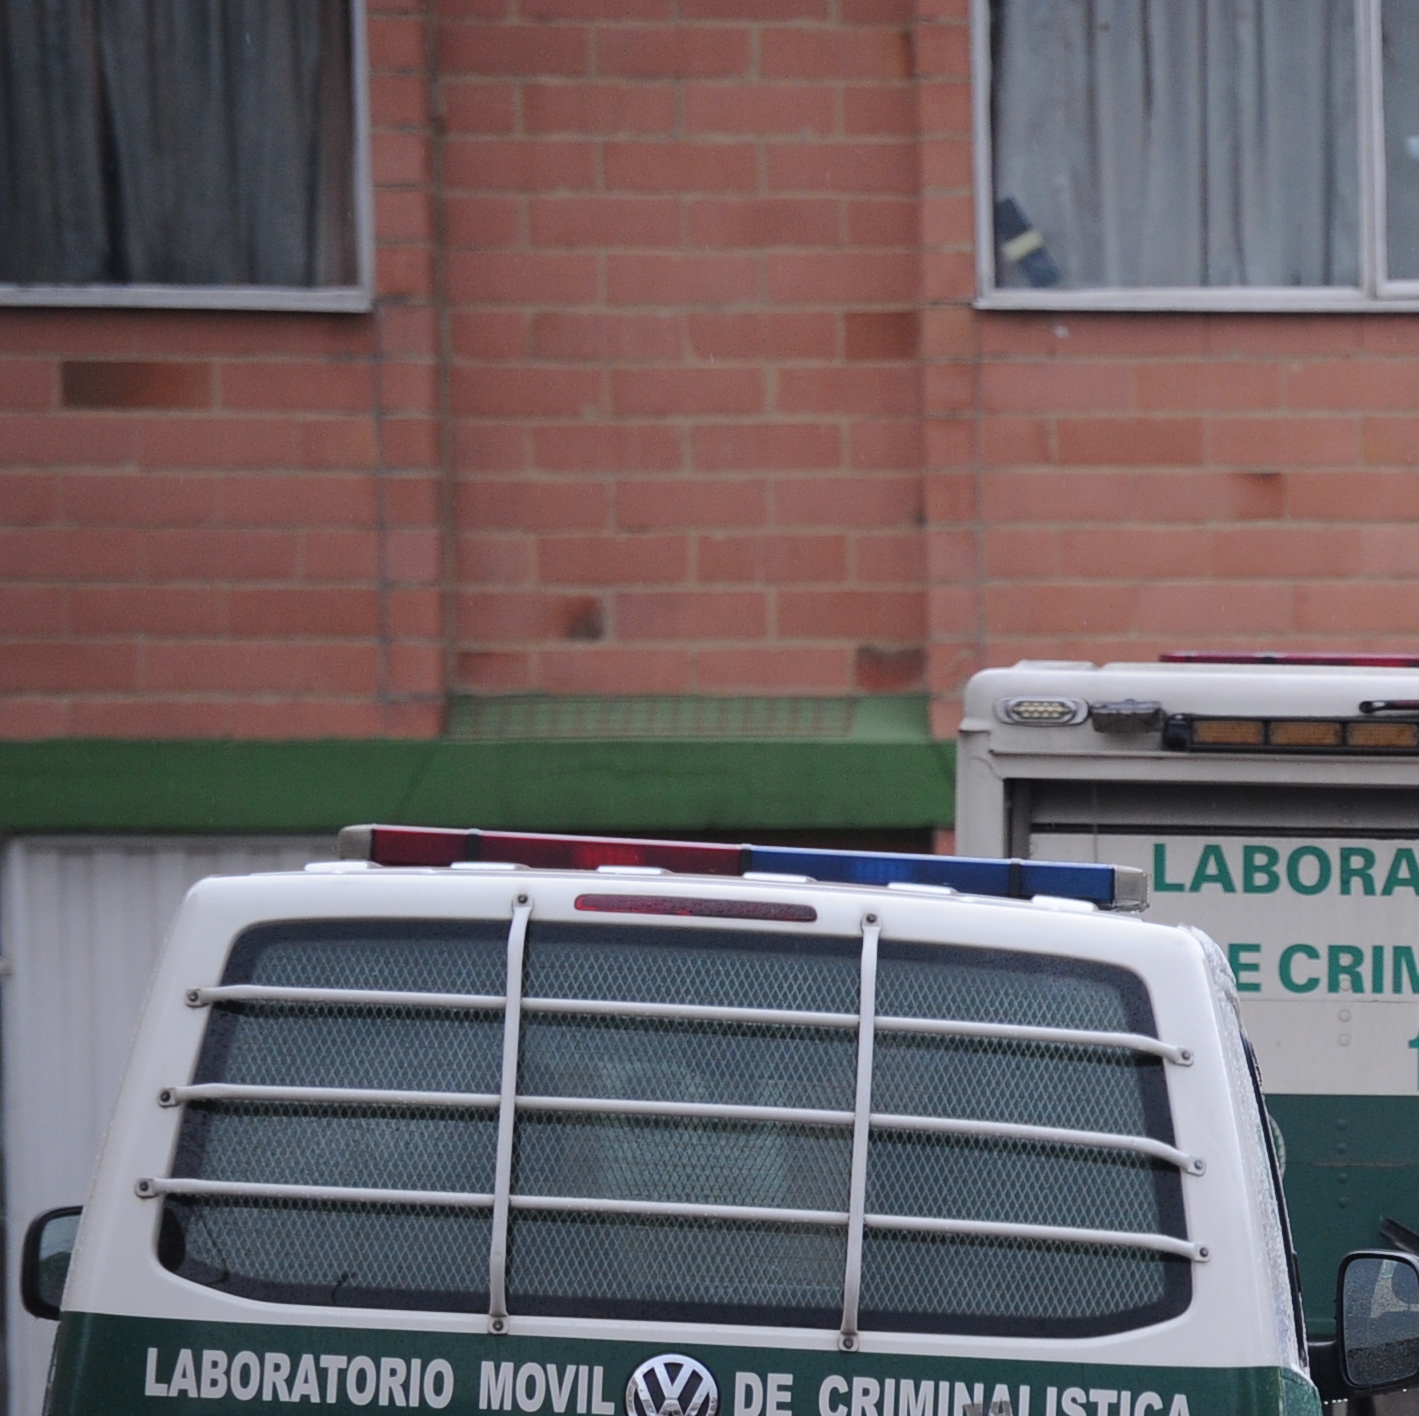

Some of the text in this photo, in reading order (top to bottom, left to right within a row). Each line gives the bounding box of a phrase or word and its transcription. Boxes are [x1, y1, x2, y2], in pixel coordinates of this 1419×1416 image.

[1227, 943, 1262, 993] E
[144, 1347, 616, 1416] LABORATORIO MOVIL
